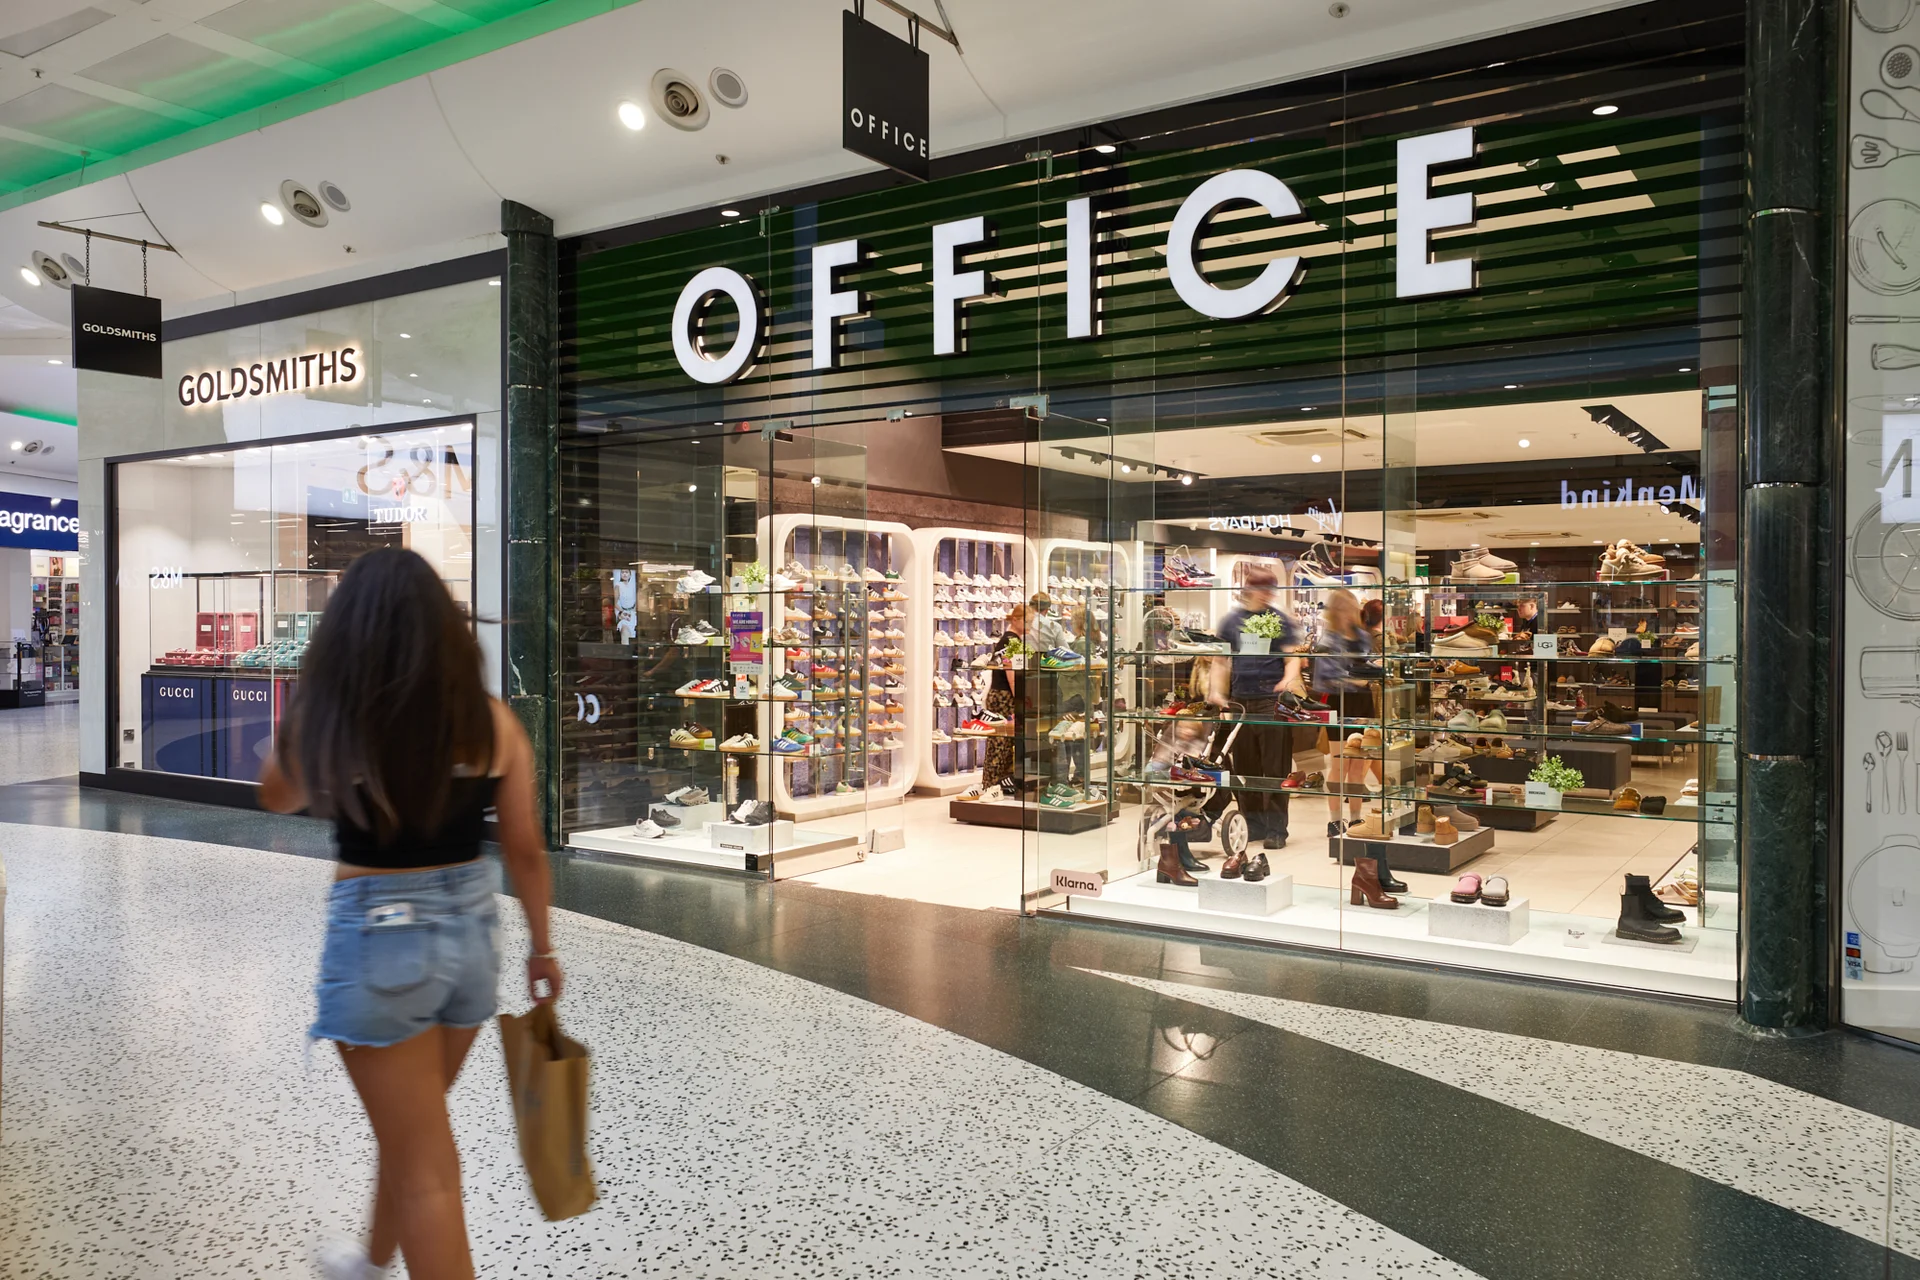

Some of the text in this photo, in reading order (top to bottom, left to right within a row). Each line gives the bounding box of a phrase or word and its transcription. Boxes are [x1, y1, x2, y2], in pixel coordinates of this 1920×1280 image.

[851, 107, 927, 158] OFFICE
[671, 125, 1476, 383] OFFICE
[82, 322, 157, 342] GOLDSMITHS
[178, 347, 357, 407] GOLDSMITHS
[373, 506, 428, 524] TUDOR
[159, 686, 194, 699] GUCCI
[232, 689, 267, 702] GUCCI
[1056, 875, 1097, 891] Klarna.
